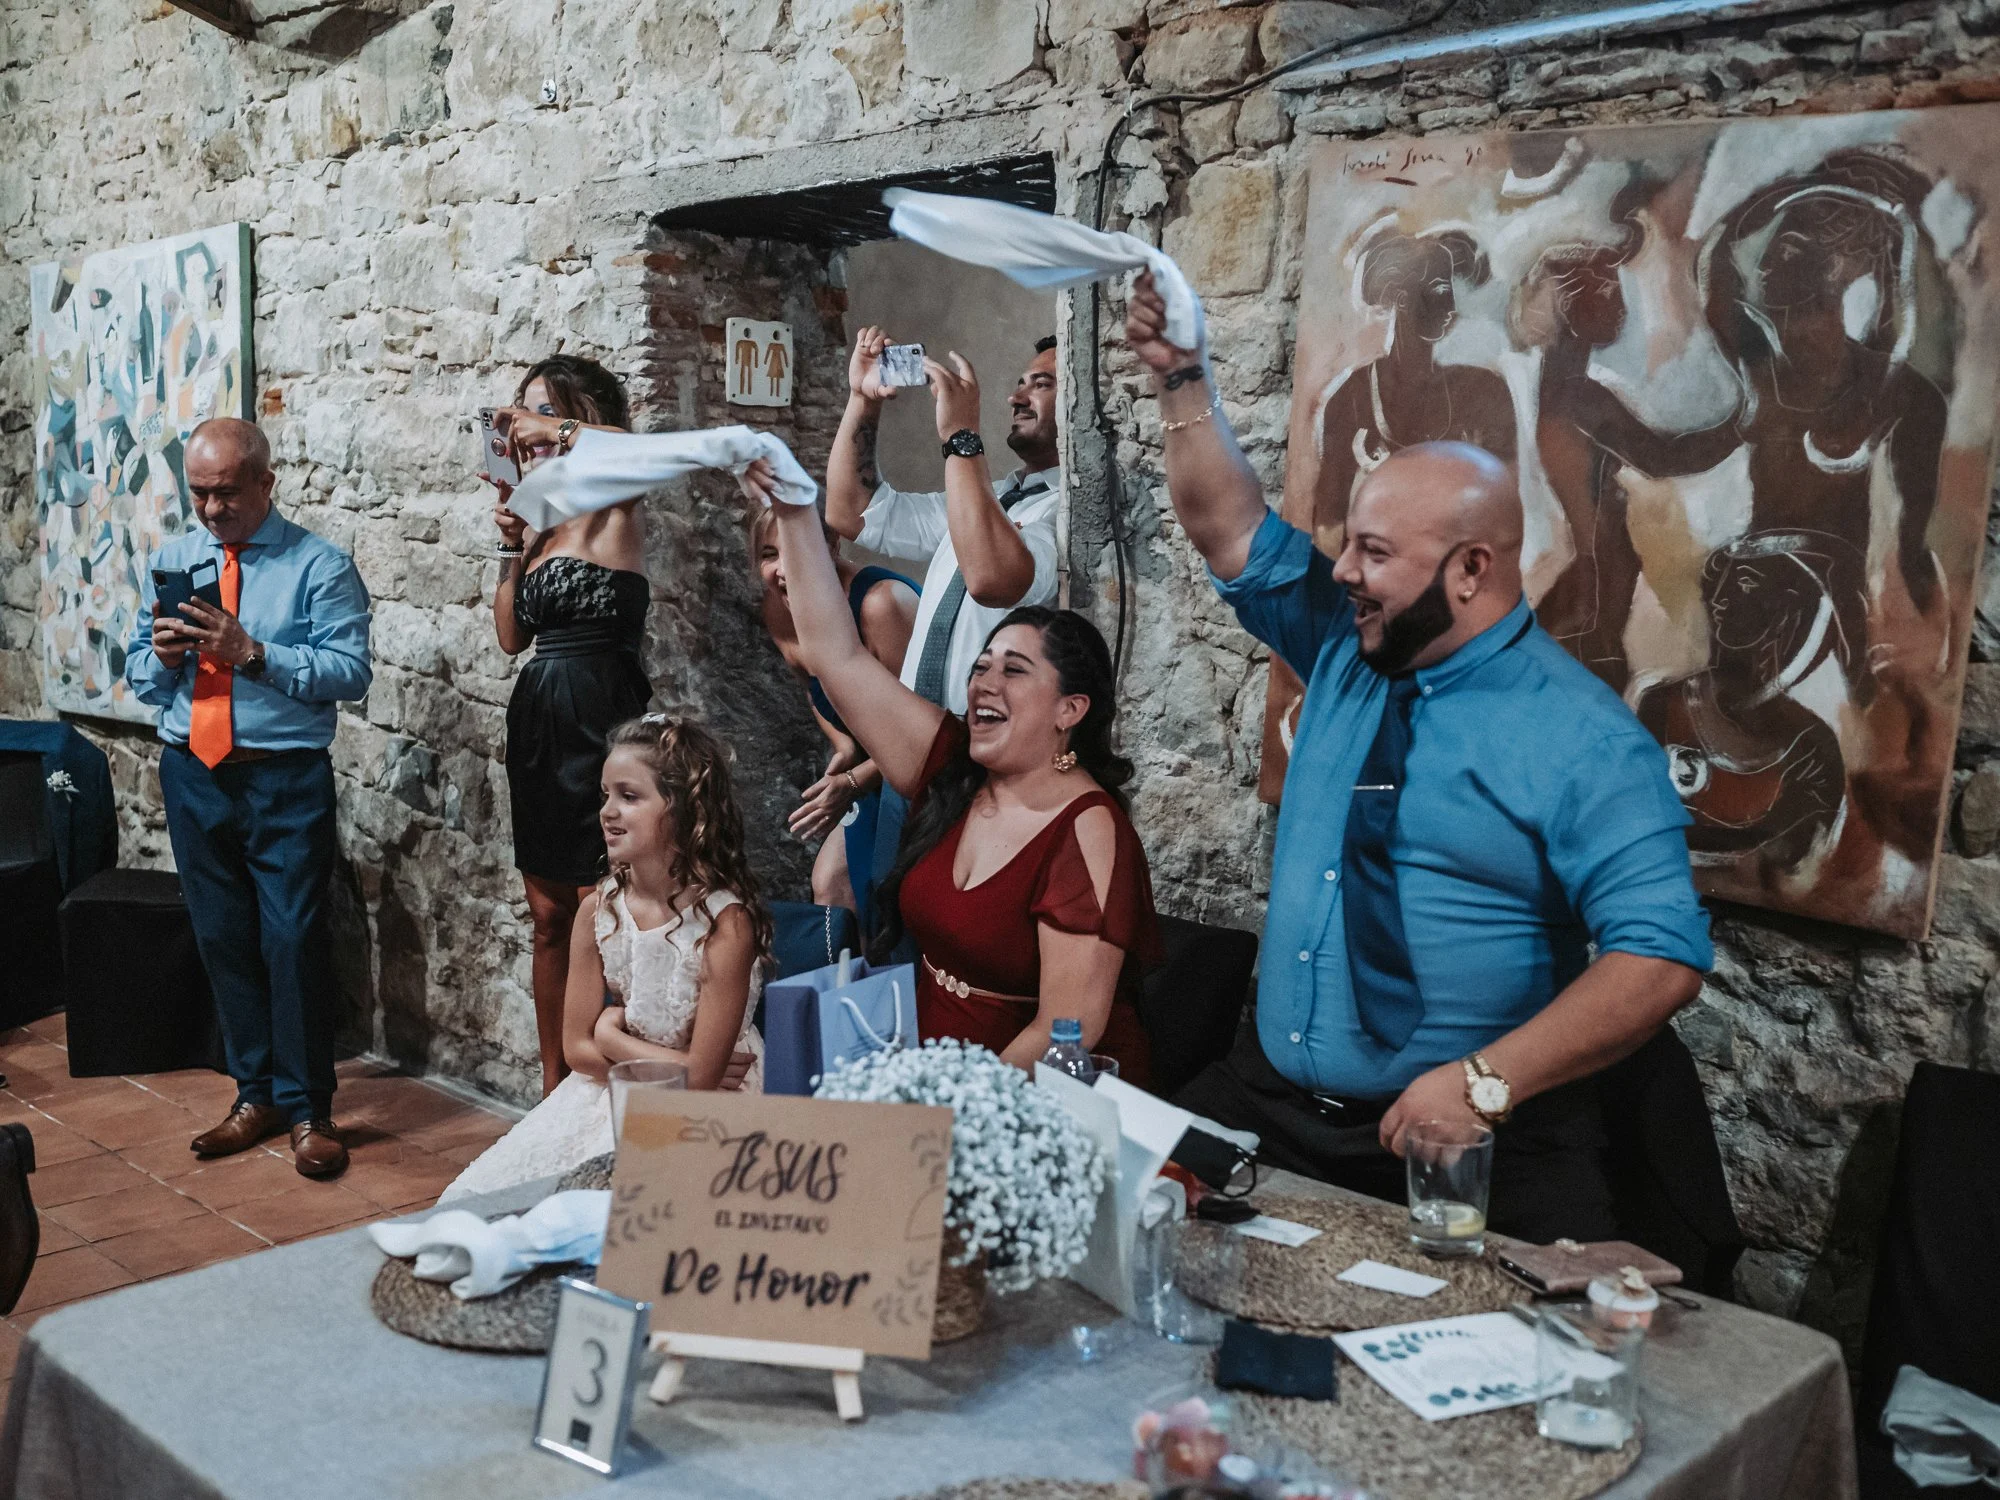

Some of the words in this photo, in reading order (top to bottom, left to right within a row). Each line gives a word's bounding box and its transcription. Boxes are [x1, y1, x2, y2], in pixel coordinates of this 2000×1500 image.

[714, 1208, 733, 1229] EL
[662, 1247, 724, 1296] De
[734, 1252, 872, 1308] Honor
[572, 1336, 609, 1409] 3
